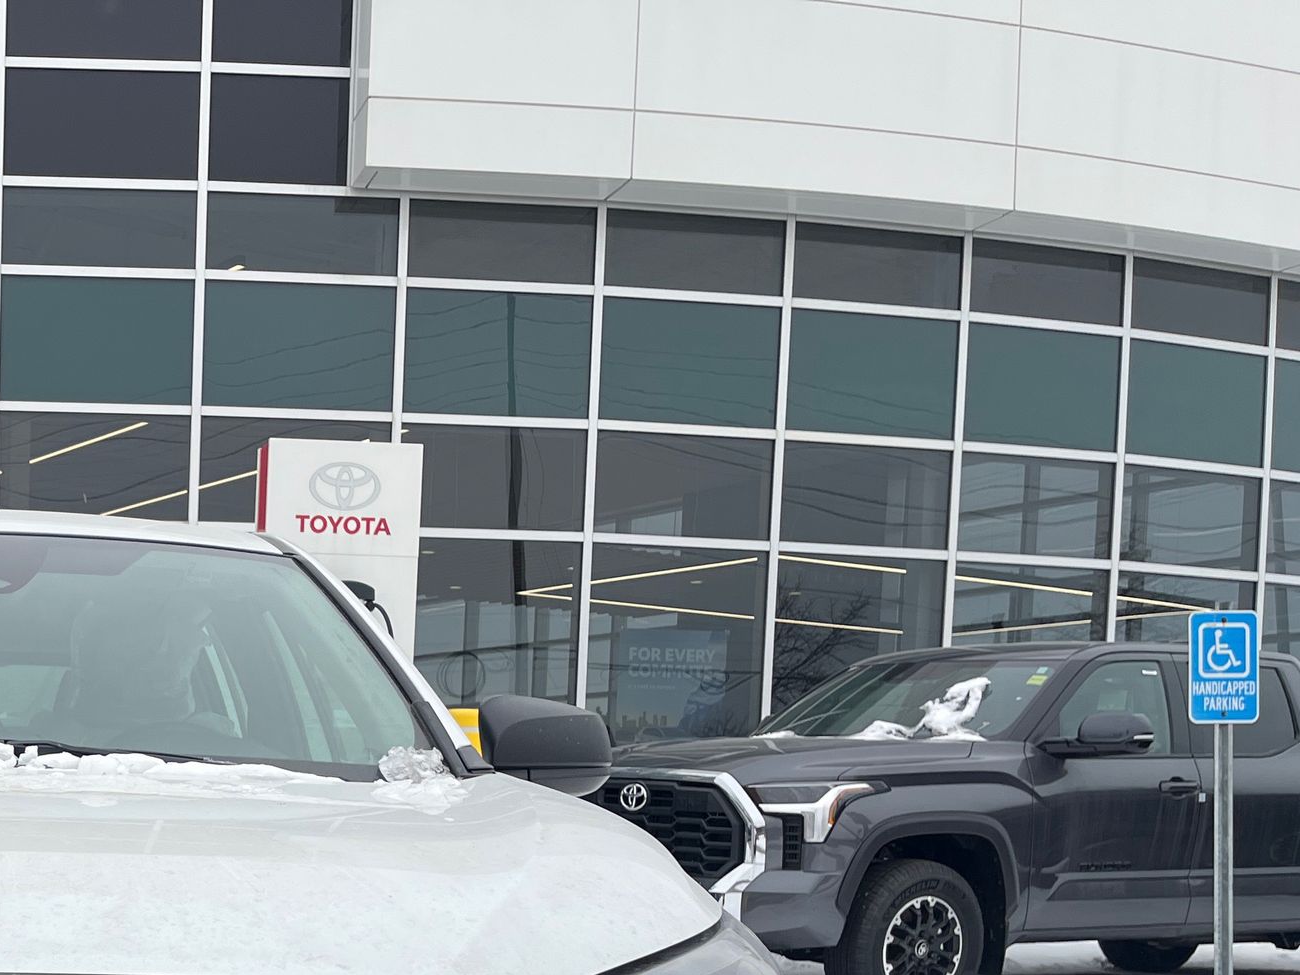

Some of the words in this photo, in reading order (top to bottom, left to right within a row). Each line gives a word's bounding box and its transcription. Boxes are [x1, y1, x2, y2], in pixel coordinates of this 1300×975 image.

[296, 515, 391, 536] TOYOTA
[628, 647, 661, 662] FOR
[665, 648, 715, 664] EVERY
[1193, 680, 1256, 695] HANDICAPPED
[1204, 697, 1245, 711] PARKING
